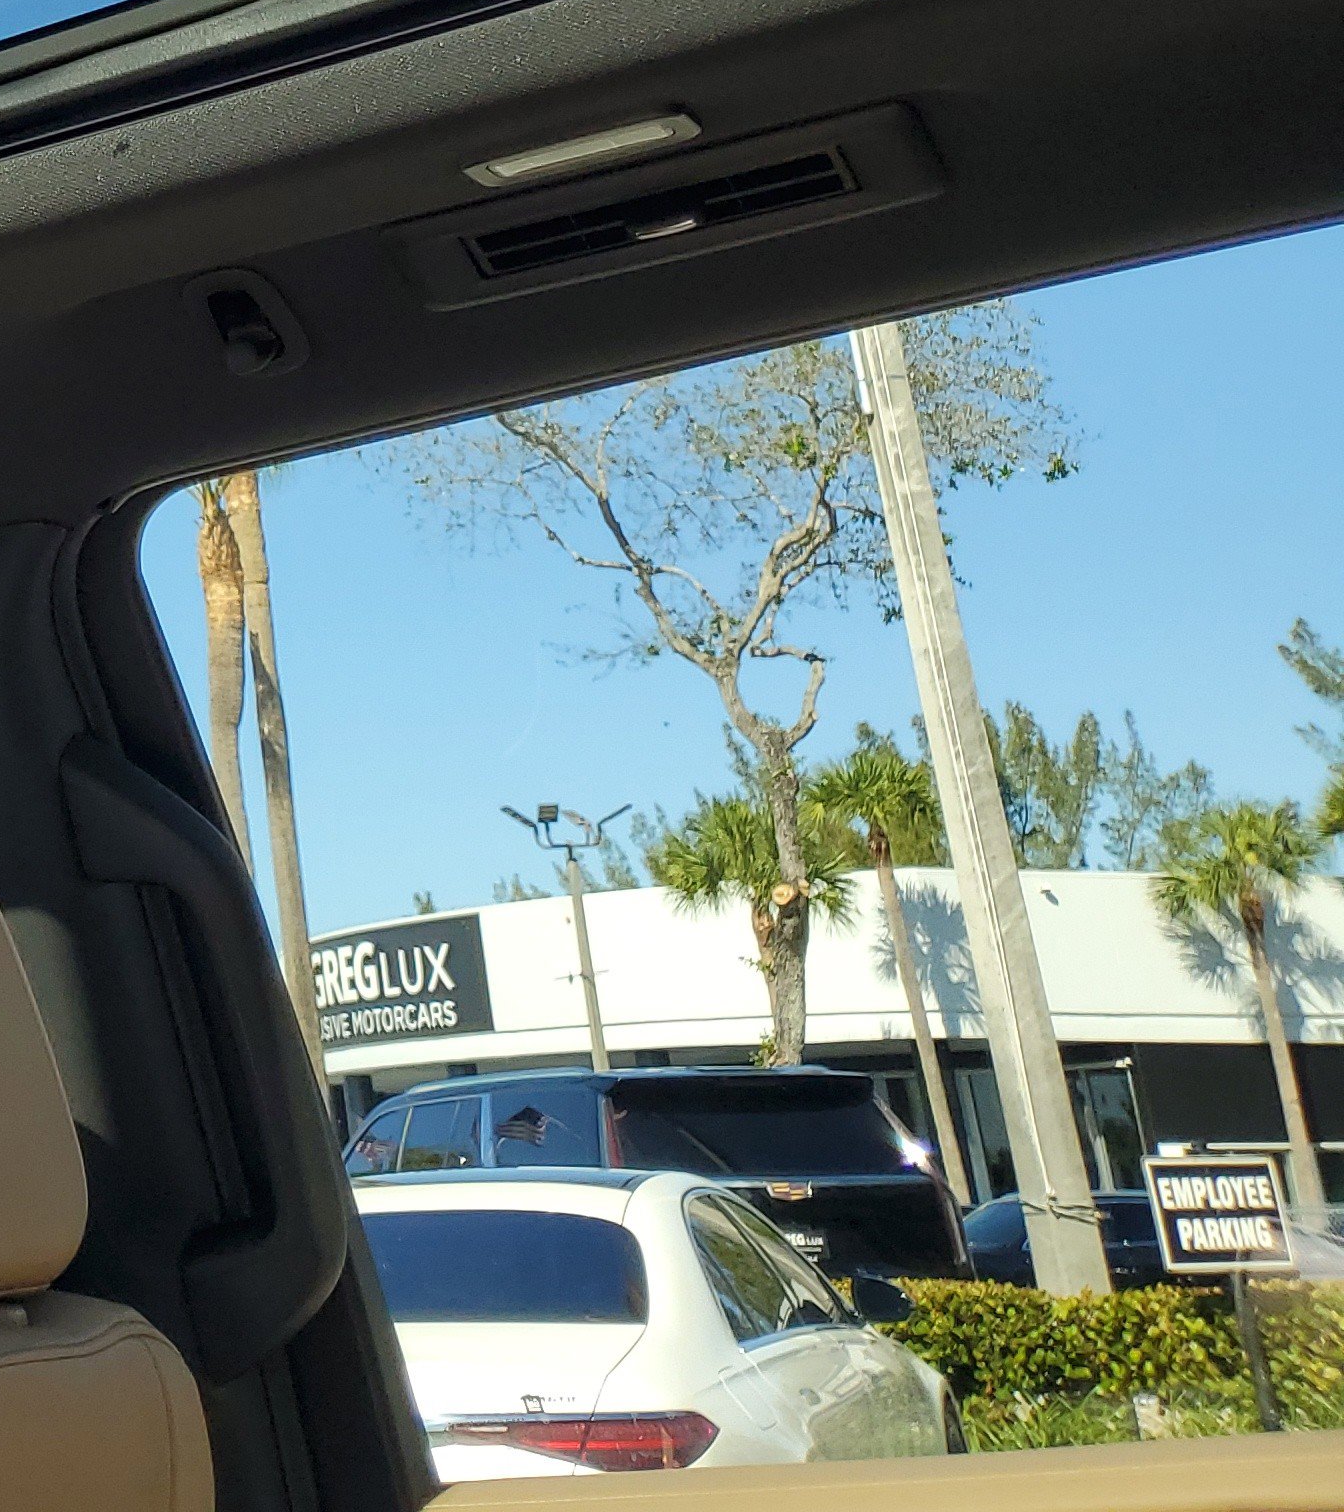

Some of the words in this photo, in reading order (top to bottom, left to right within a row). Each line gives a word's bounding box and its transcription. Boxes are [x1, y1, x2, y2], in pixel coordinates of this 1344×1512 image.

[379, 942, 456, 996] LUX
[321, 1012, 353, 1042] SIVE
[351, 1000, 458, 1036] MOTORCARS
[1157, 1176, 1275, 1211] EMPLOYEE
[1177, 1216, 1273, 1251] PARKING
